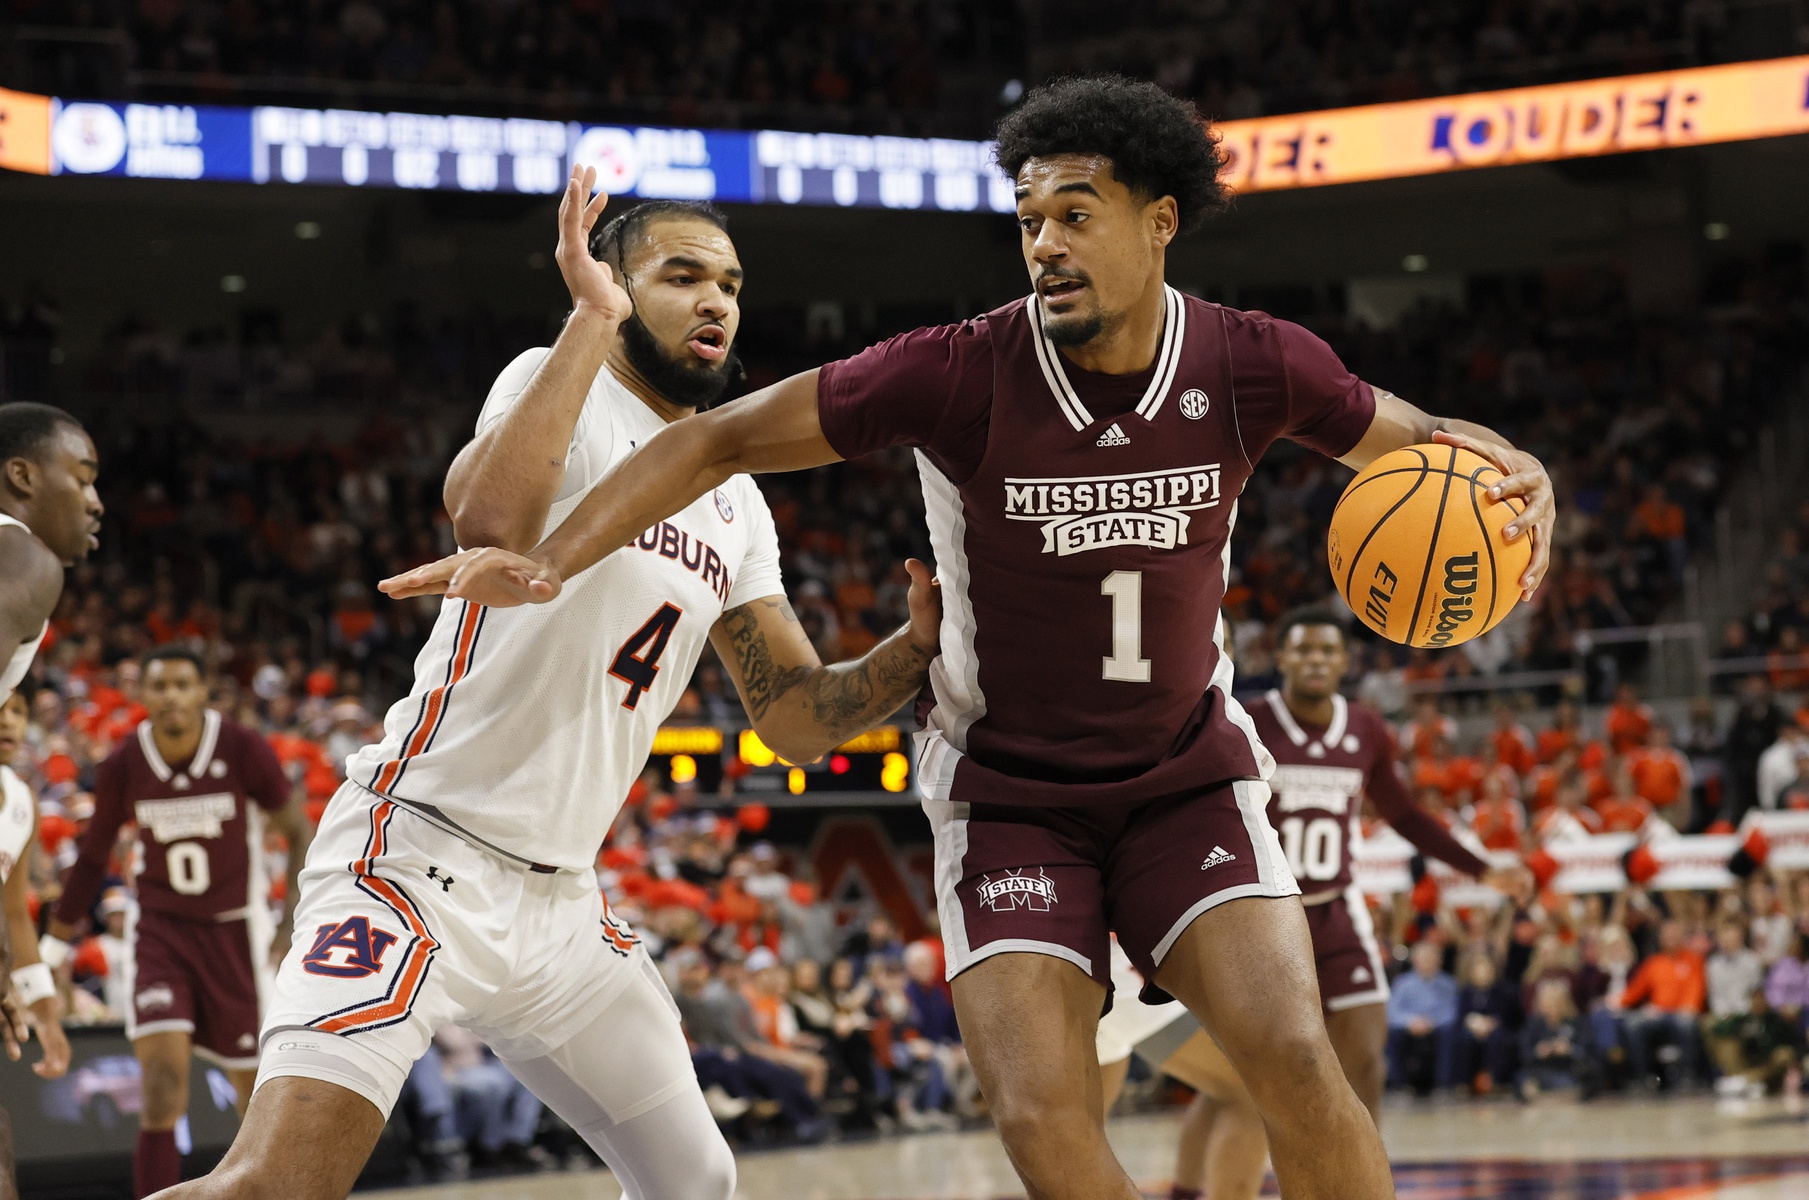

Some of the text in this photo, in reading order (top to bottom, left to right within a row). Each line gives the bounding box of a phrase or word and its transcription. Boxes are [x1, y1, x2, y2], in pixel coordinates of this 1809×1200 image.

[1426, 86, 1706, 167] LOUDER
[1183, 391, 1206, 417] SEC
[1096, 436, 1131, 447] adidas
[1005, 470, 1221, 514] MISSISSIPPI
[1068, 518, 1166, 549] STATE
[625, 520, 733, 615] UBURN
[1366, 561, 1398, 629] EVO
[1101, 570, 1151, 682] 1
[1421, 551, 1479, 649] Wilson
[607, 601, 683, 711] 4
[166, 841, 211, 896] 0
[1200, 853, 1236, 871] adidas
[1281, 816, 1342, 880] 10
[992, 878, 1042, 895] STATE
